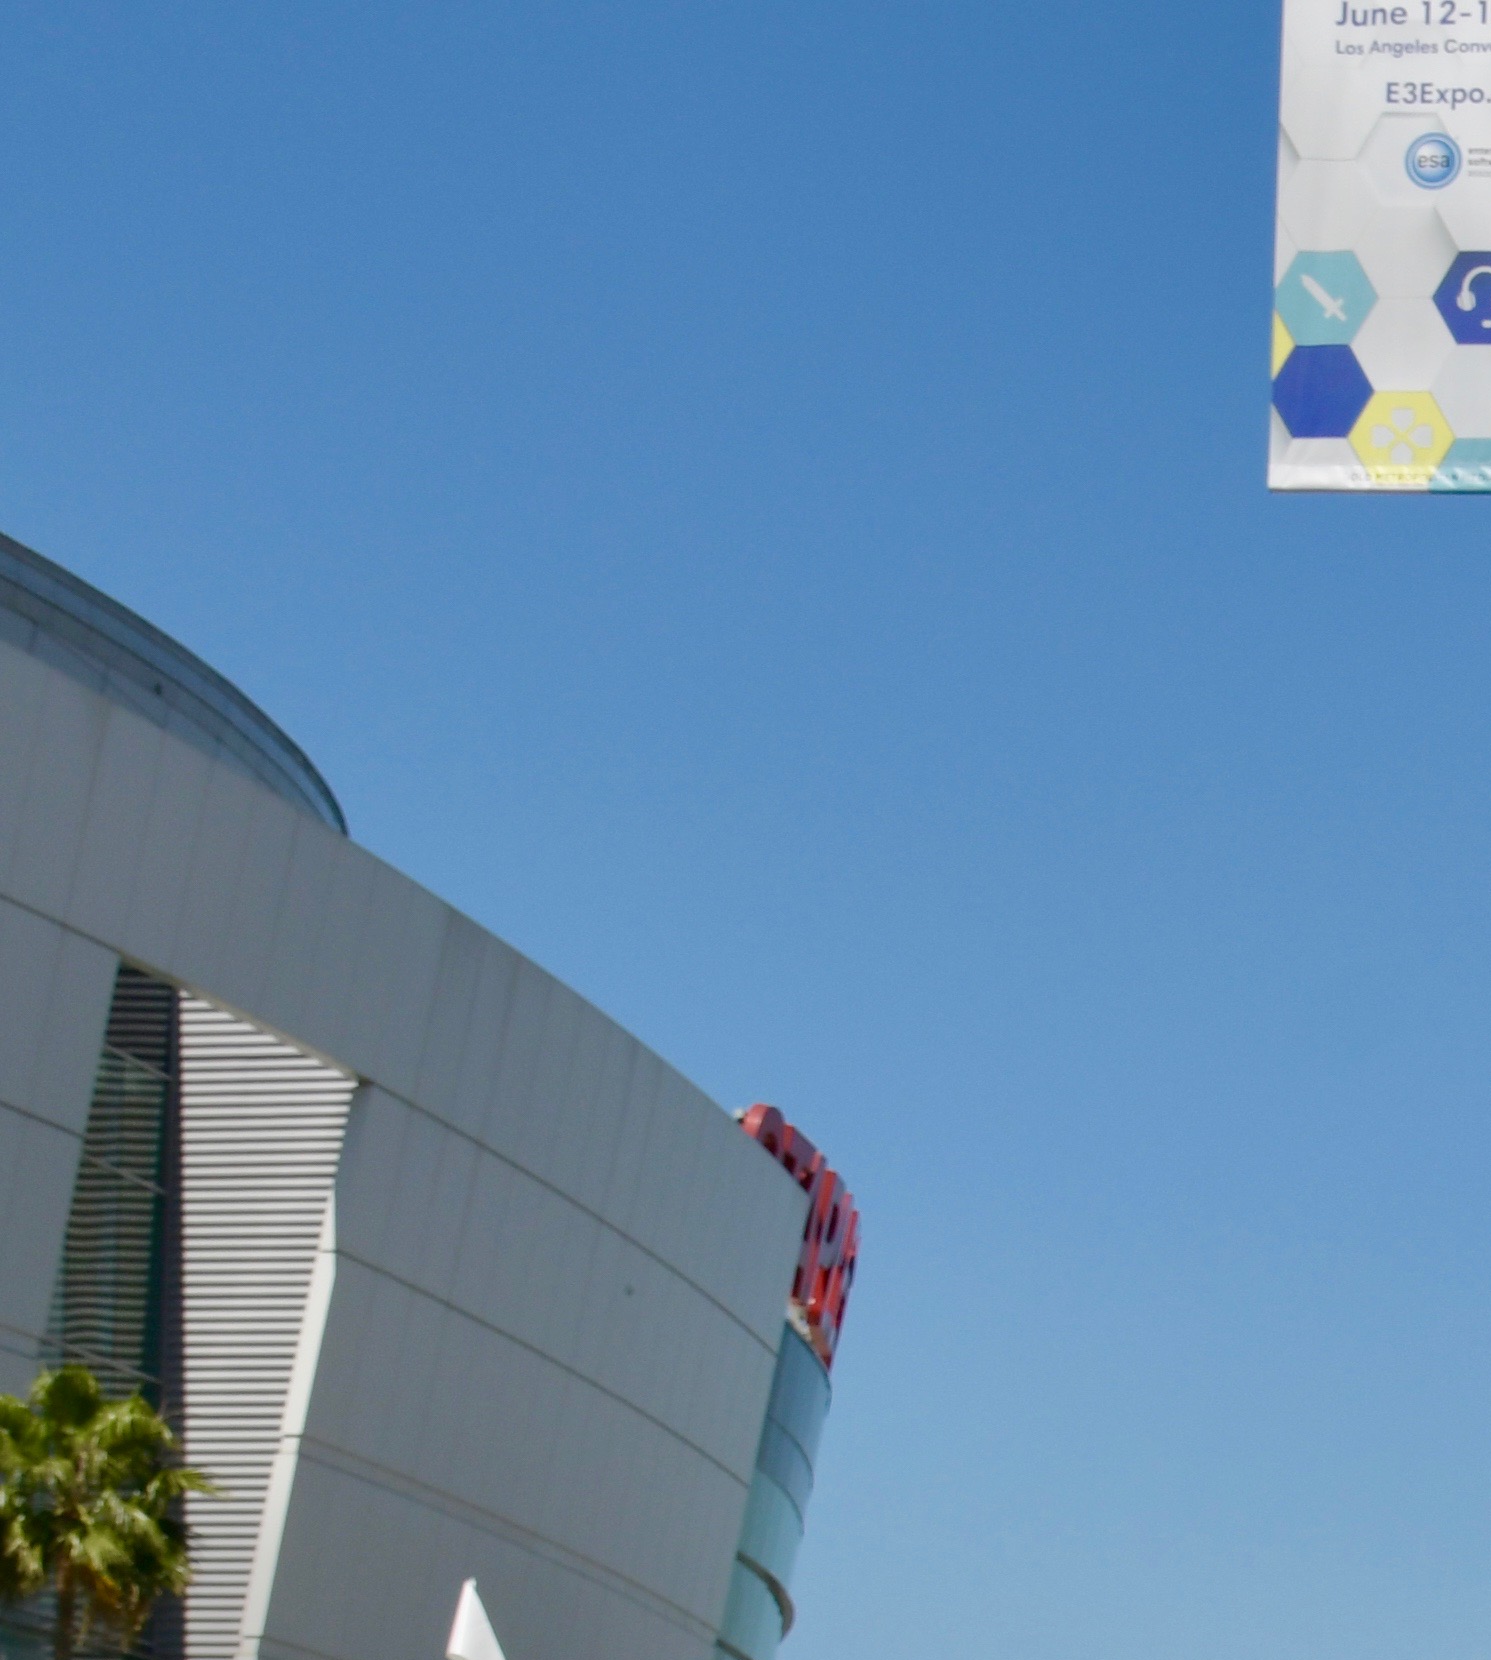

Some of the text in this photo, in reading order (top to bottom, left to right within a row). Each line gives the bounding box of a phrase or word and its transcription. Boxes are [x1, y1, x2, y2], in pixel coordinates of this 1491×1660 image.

[1335, 0, 1408, 26] June
[1335, 40, 1364, 55] Los
[1369, 40, 1439, 58] Angeles
